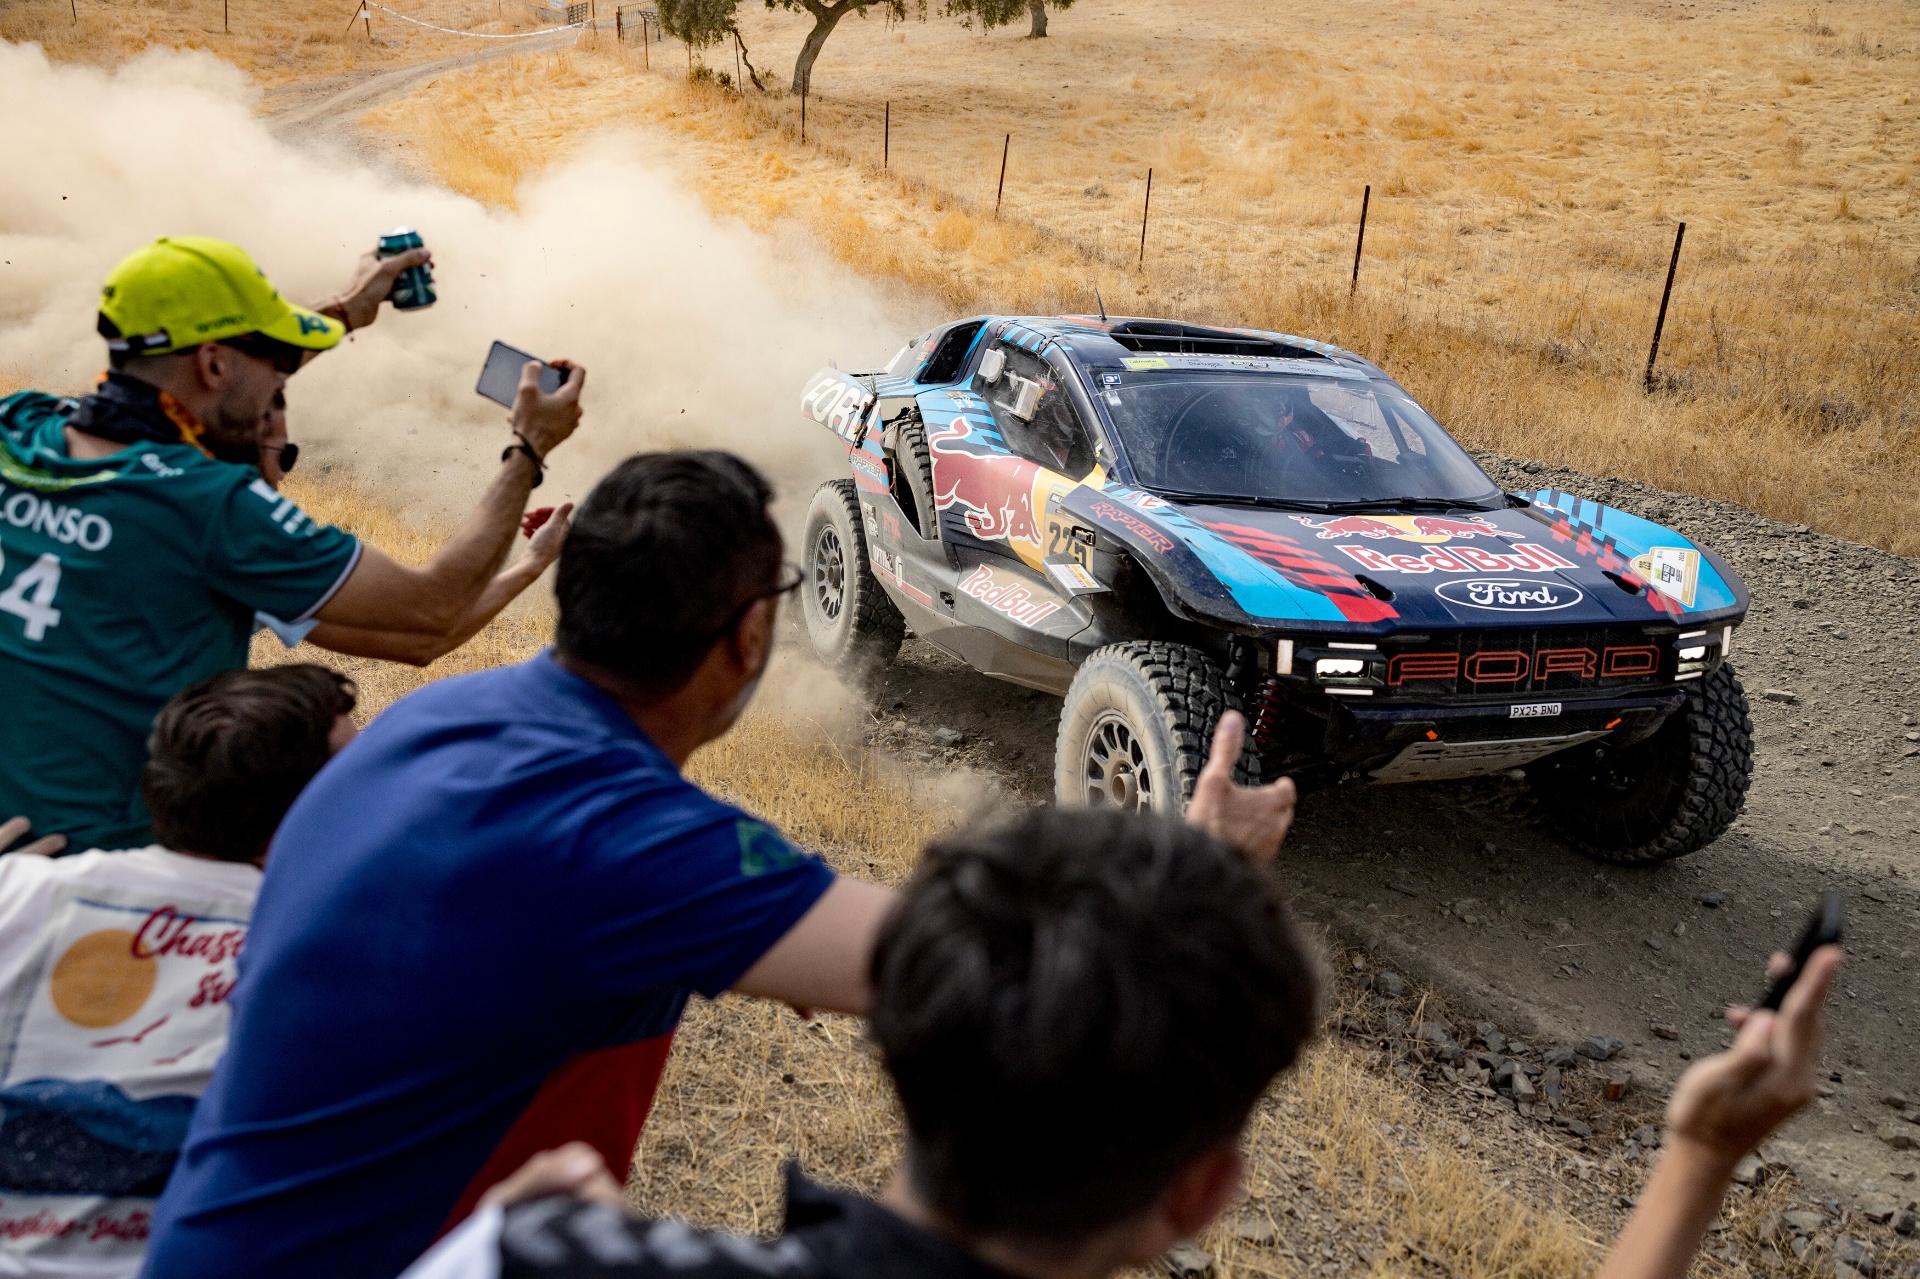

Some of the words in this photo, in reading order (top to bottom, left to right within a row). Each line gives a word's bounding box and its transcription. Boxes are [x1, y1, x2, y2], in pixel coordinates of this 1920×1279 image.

[801, 377, 882, 442] FORD
[851, 454, 882, 483] RAPTOR
[1090, 502, 1175, 555] RAPTOR
[0, 537, 62, 642] 4
[1466, 582, 1558, 605] Ford
[1388, 645, 1660, 686] FORD
[1513, 706, 1538, 717] PX25
